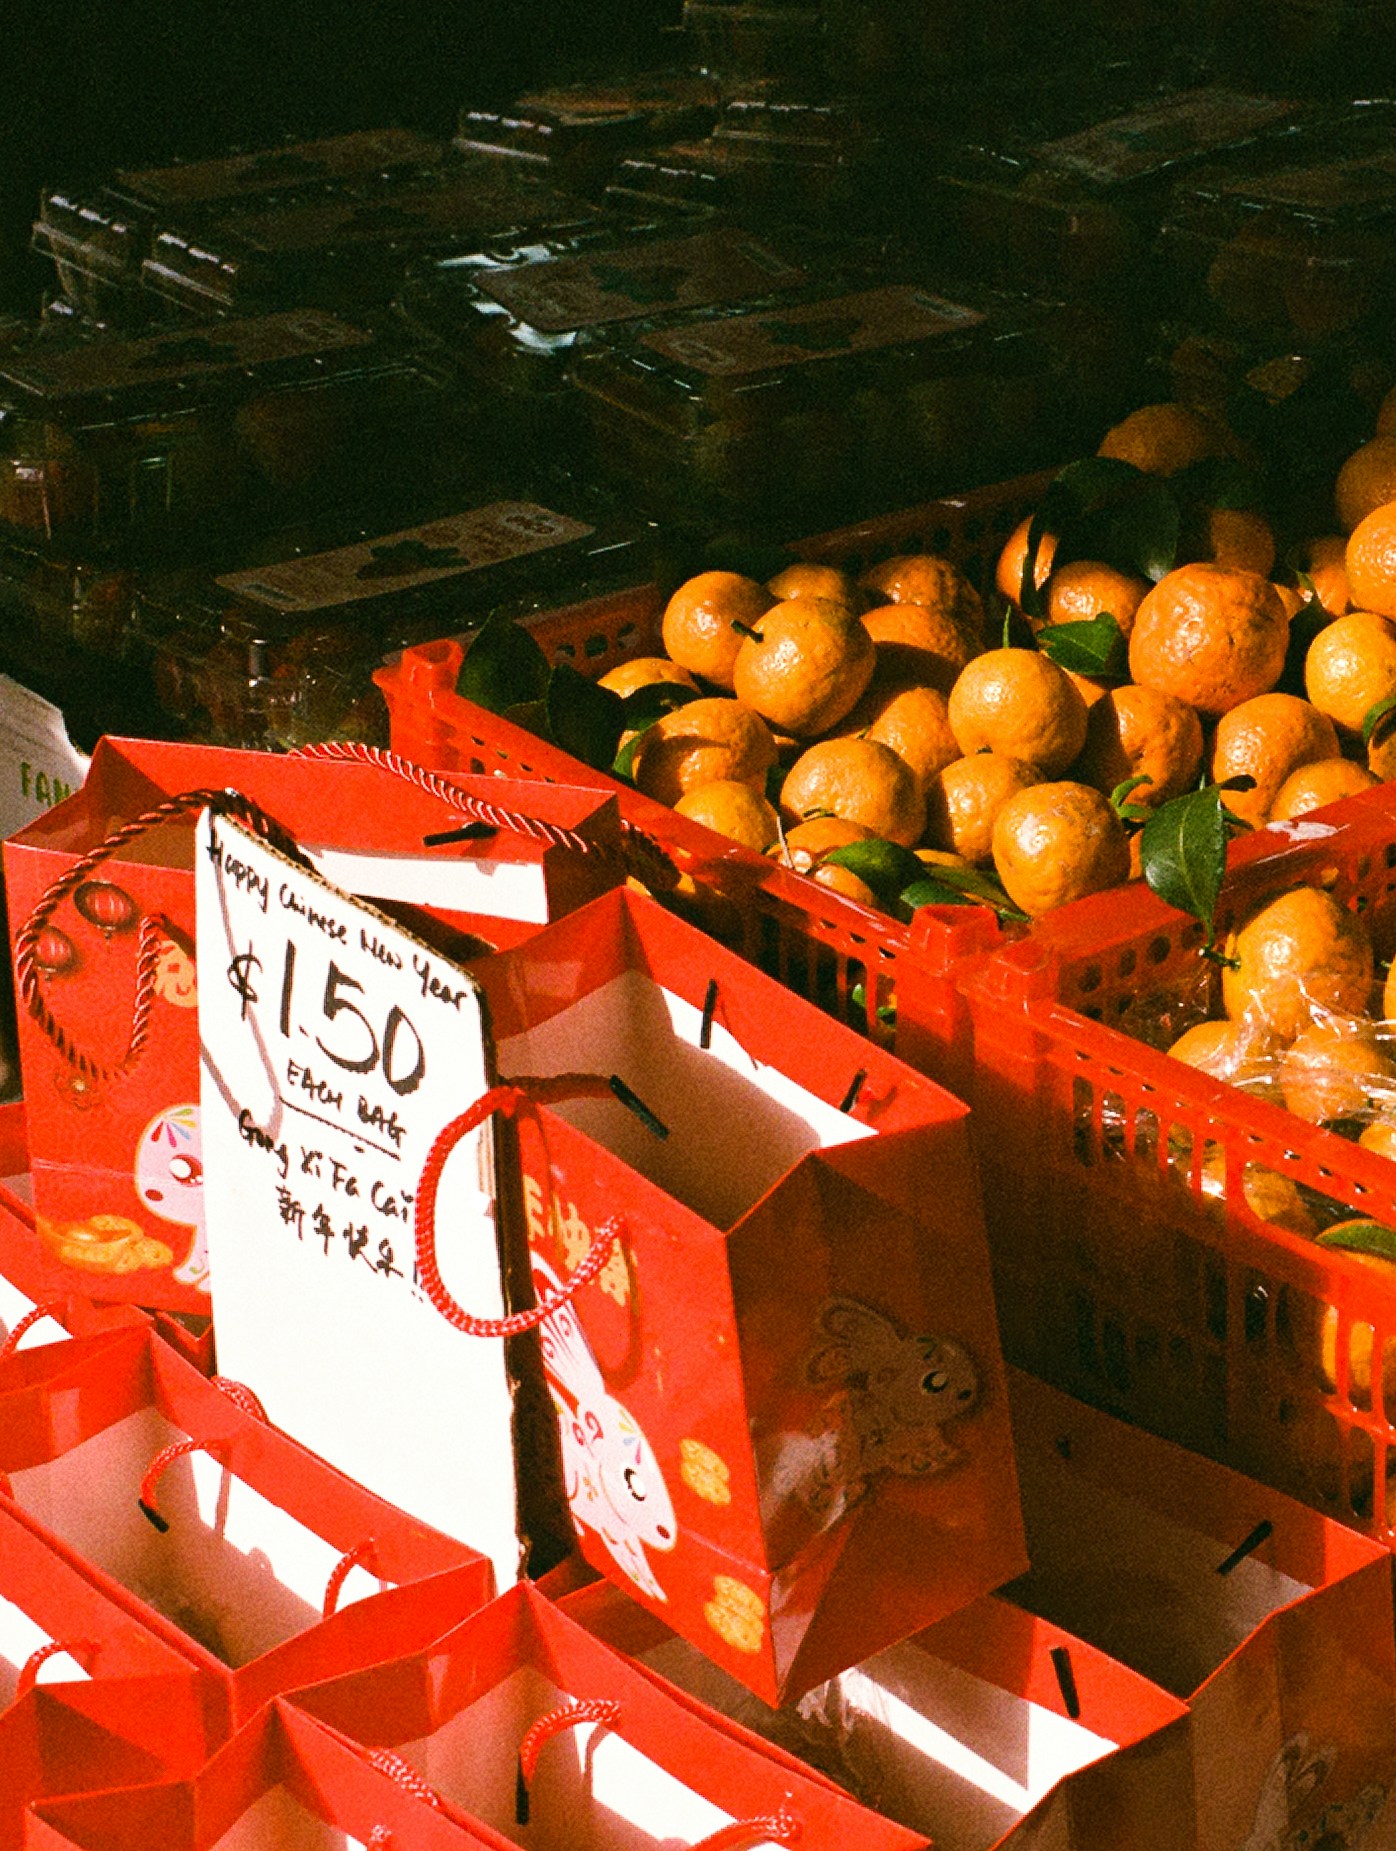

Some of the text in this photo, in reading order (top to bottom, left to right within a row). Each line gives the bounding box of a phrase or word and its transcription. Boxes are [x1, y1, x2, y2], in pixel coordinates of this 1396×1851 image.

[206, 830, 468, 1012] Happy Chinese New Year
[287, 1057, 407, 1149] EACH BAG
[239, 1108, 289, 1181] Gong
[300, 1145, 323, 1179] Xi
[329, 1157, 361, 1198] Fa
